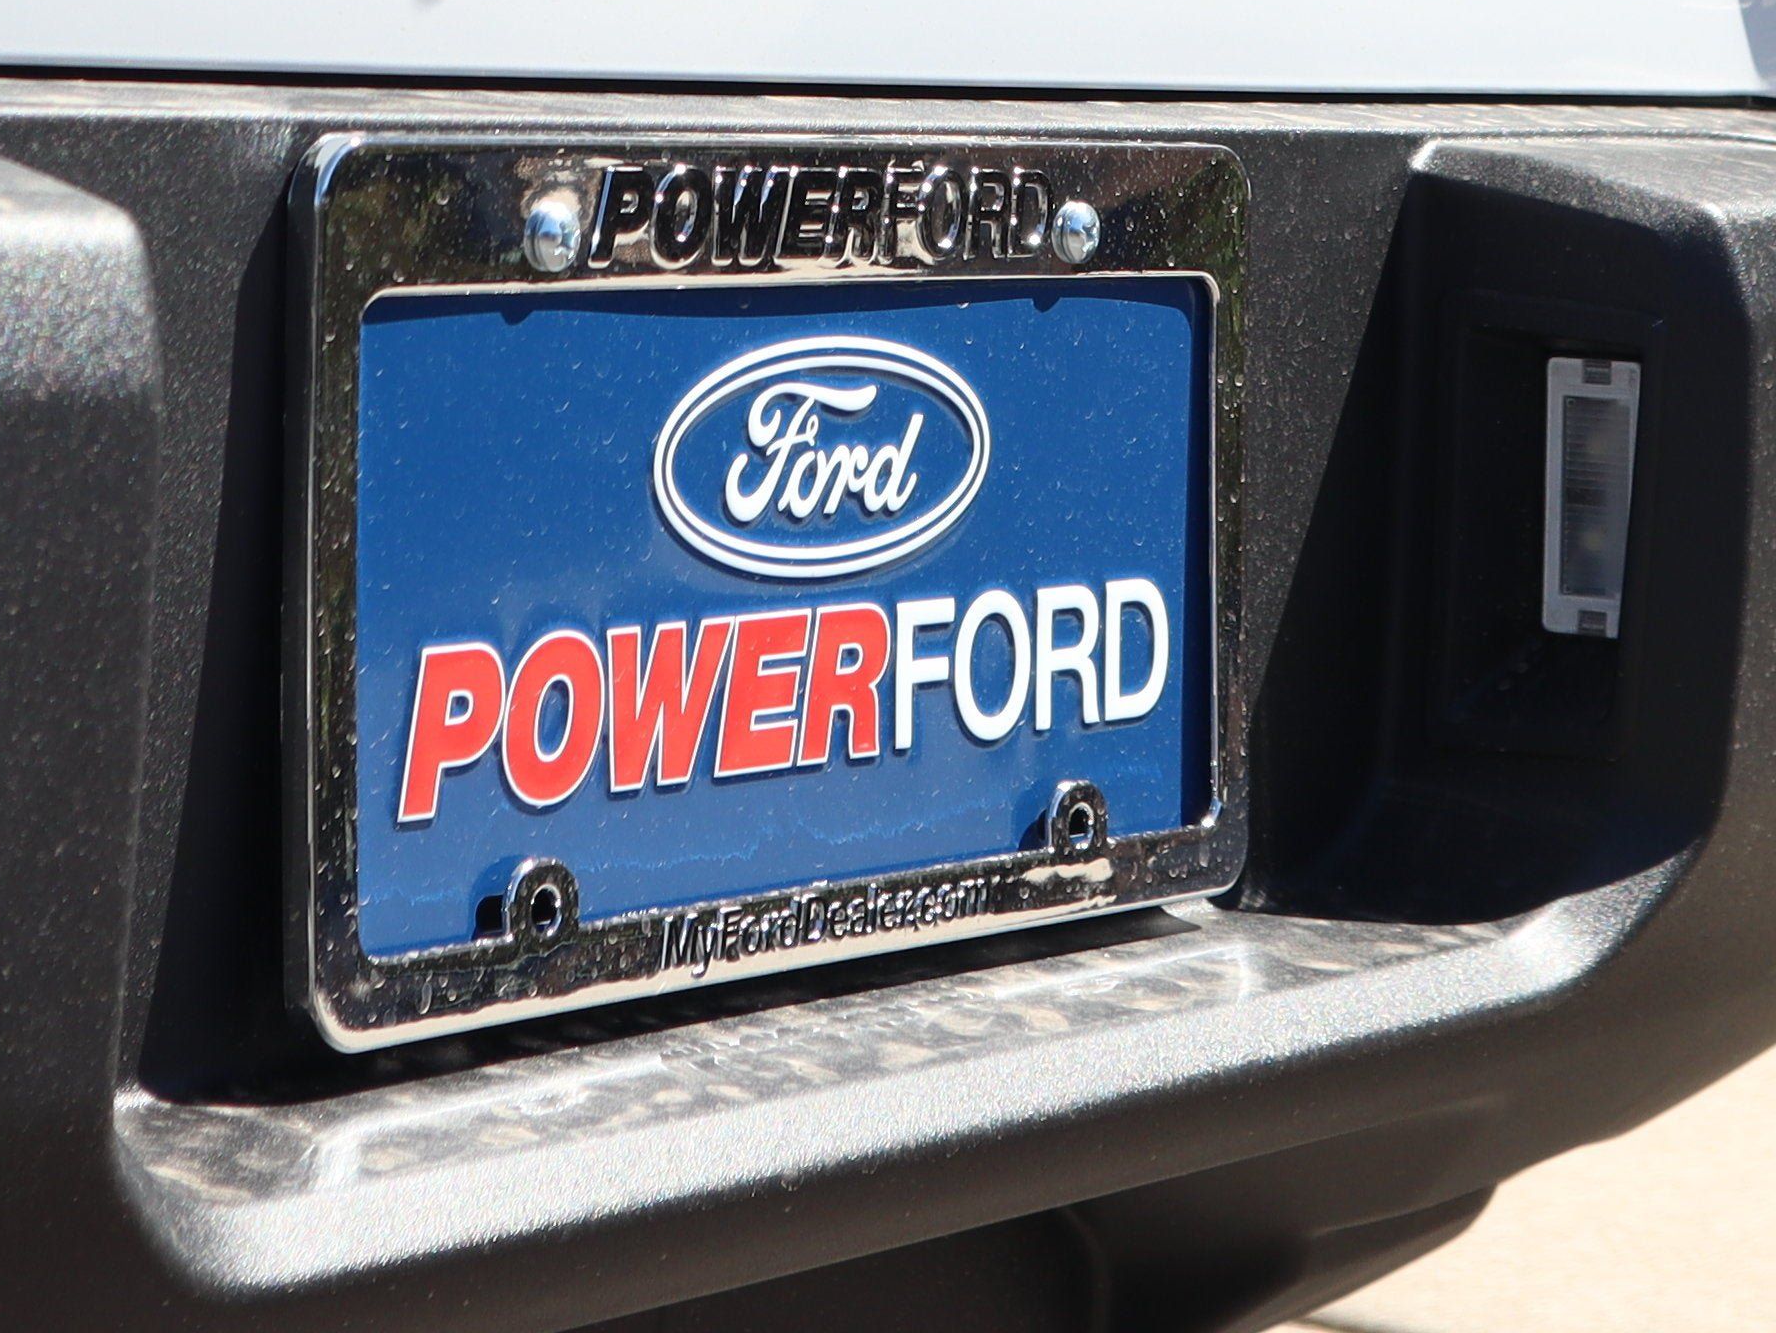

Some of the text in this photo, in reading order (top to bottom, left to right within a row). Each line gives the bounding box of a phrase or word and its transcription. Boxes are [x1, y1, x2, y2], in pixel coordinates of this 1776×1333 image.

[588, 164, 1054, 271] POWERFORD
[724, 381, 923, 520] Ford
[397, 577, 1170, 823] POWERFORD
[658, 877, 991, 978] MyFordDealer.com
